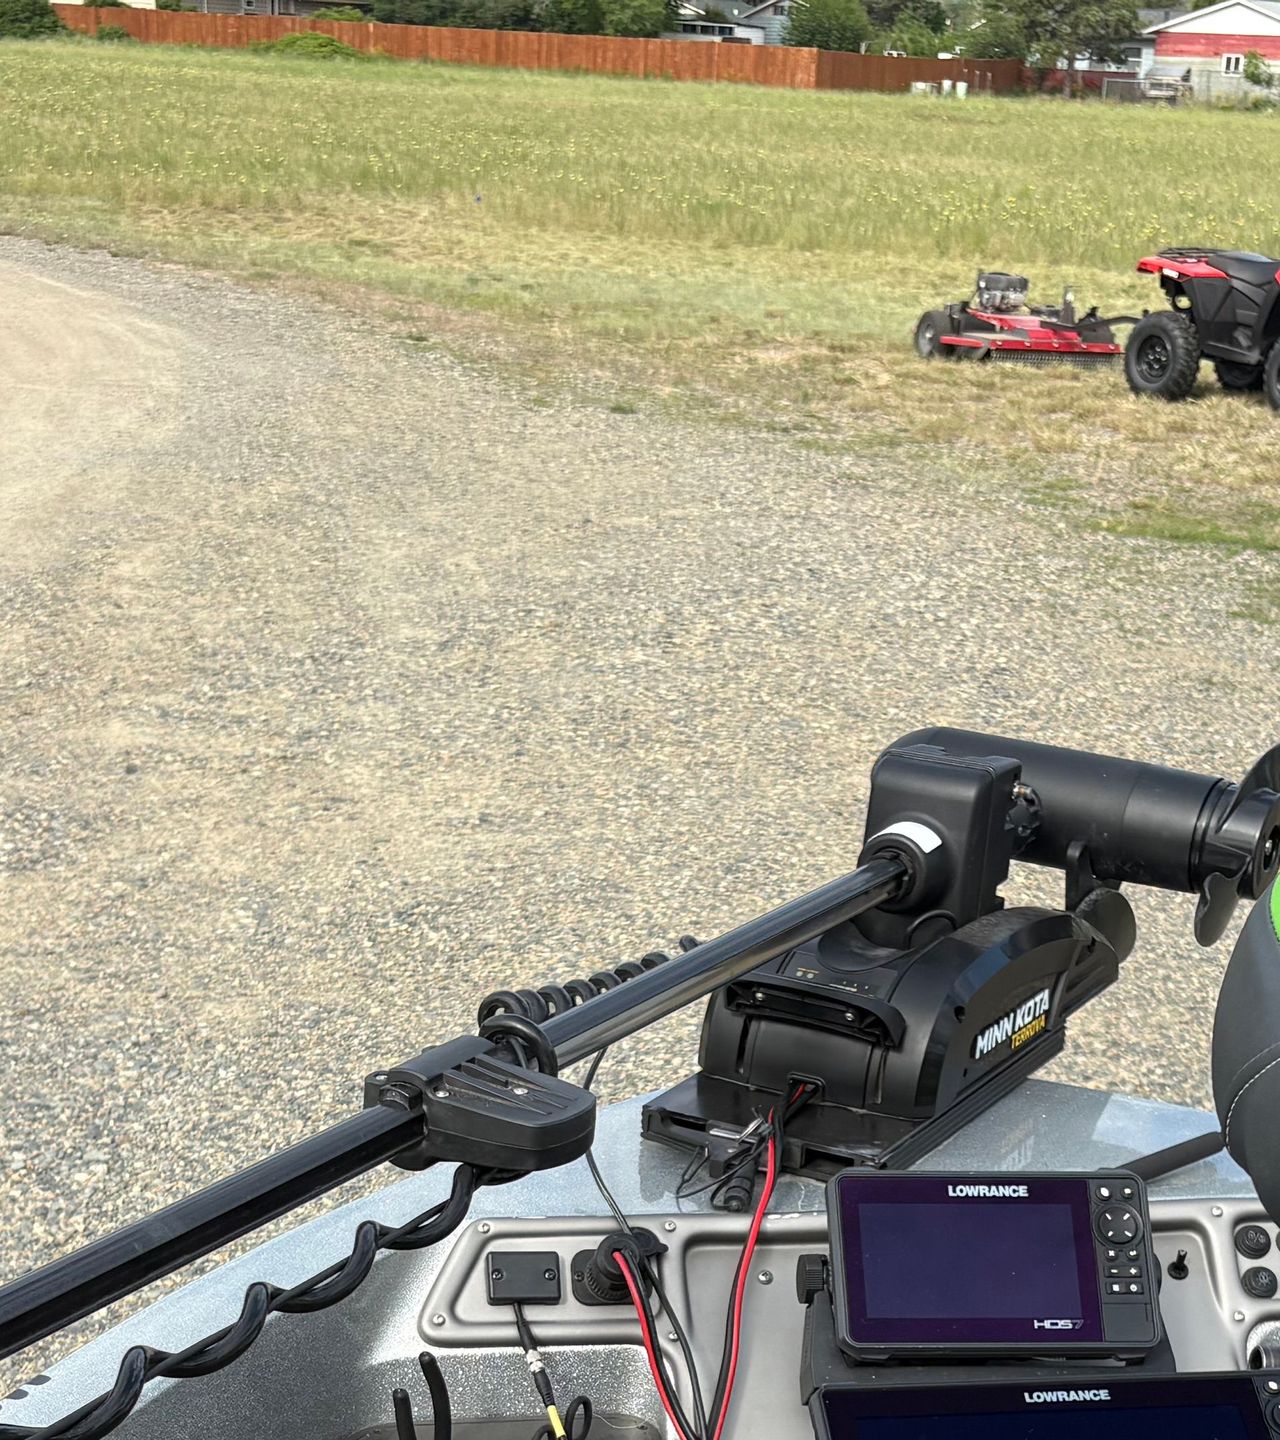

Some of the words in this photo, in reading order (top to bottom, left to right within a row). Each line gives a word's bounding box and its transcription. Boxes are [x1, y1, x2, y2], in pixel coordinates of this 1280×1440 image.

[975, 1012, 1014, 1059] MINN
[1014, 988, 1050, 1033] KOTA
[1011, 1014, 1046, 1050] TERROVA
[947, 1184, 1028, 1198] LOWRANCE
[1023, 1389, 1111, 1404] LOWRANCE
